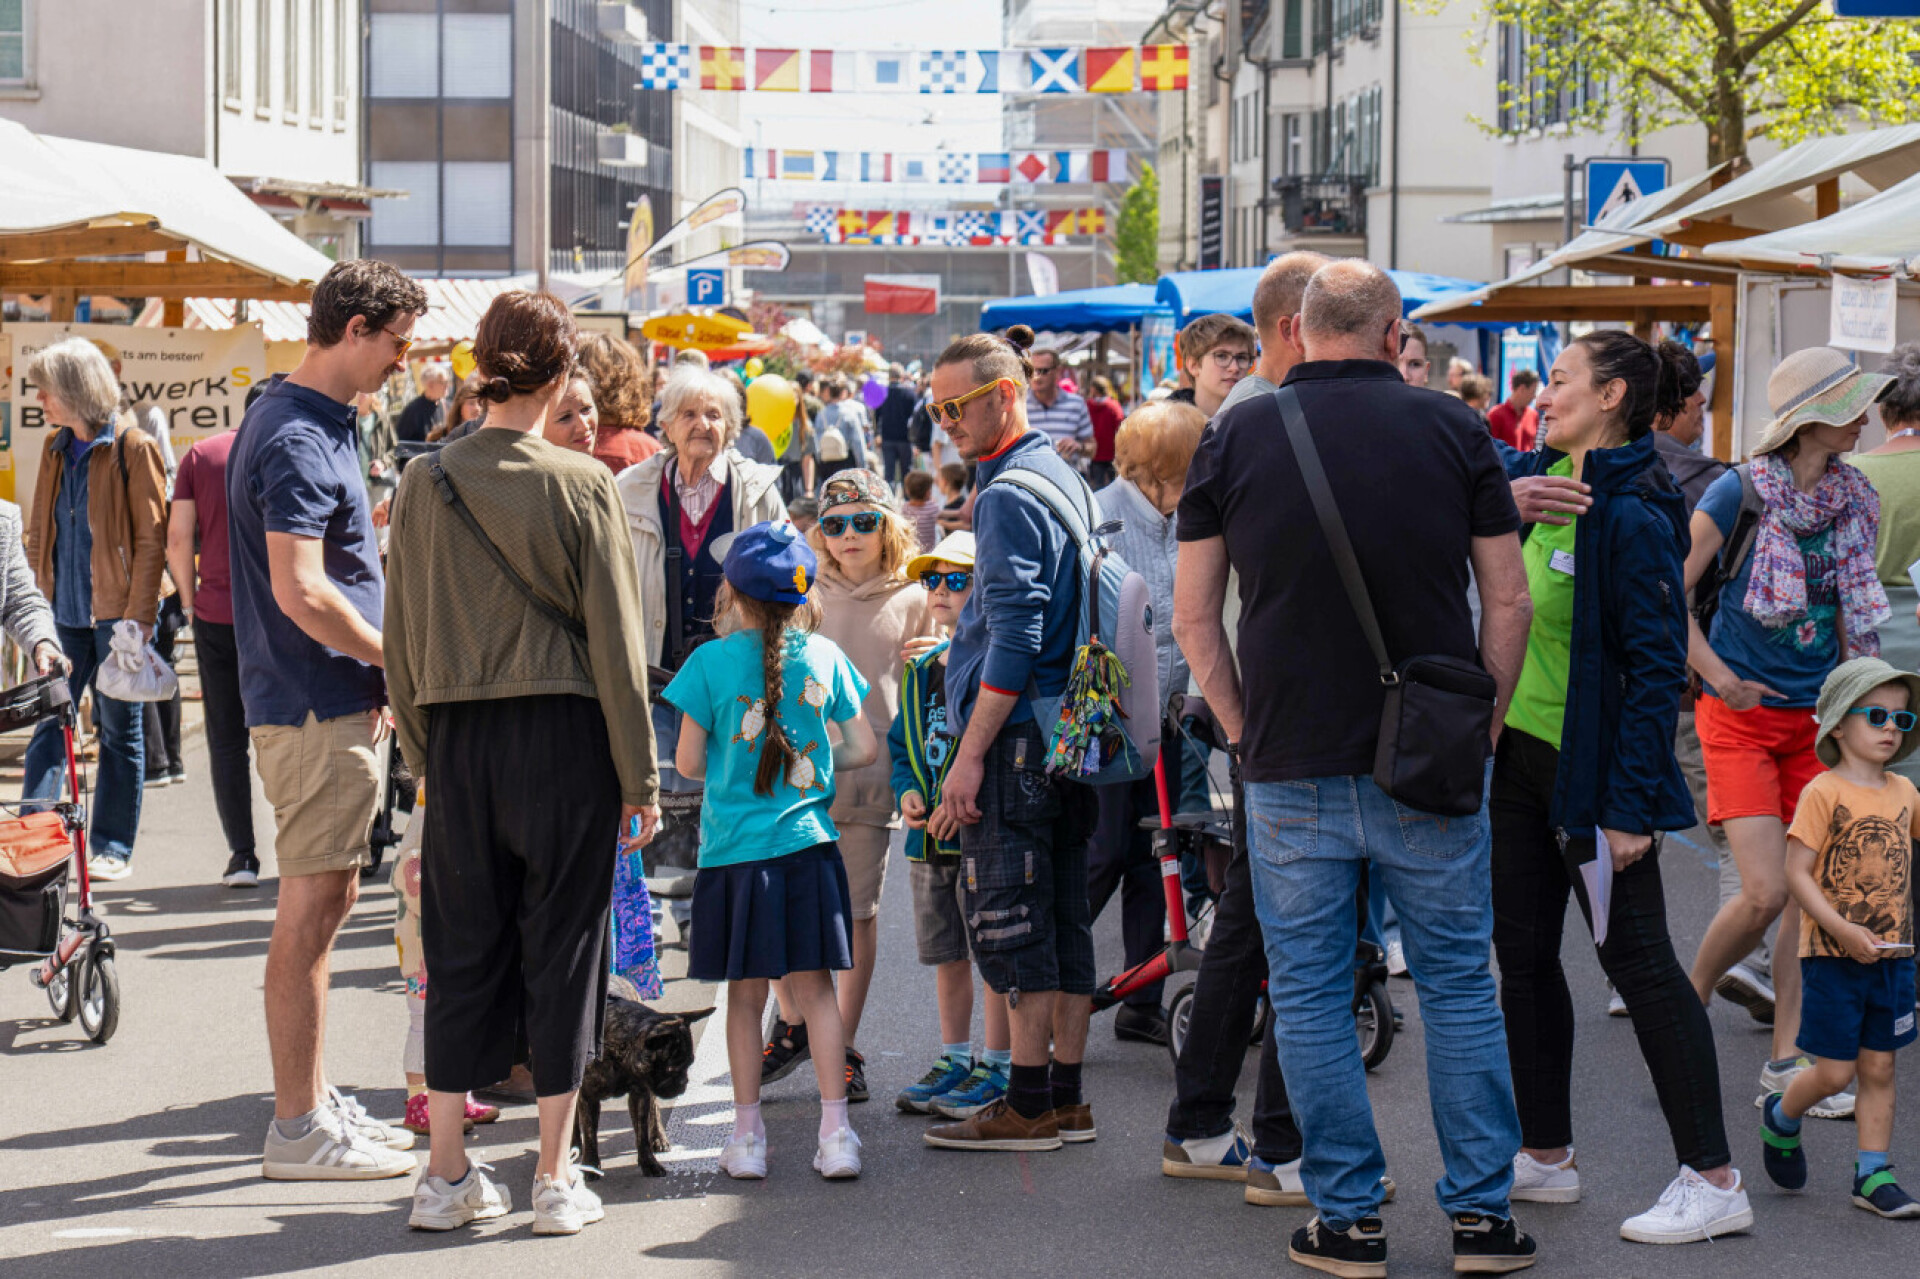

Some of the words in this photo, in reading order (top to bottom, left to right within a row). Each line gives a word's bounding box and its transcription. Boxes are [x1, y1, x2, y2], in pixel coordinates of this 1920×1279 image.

[698, 279, 713, 301] P
[137, 352, 157, 361] am
[160, 350, 204, 362] besten!
